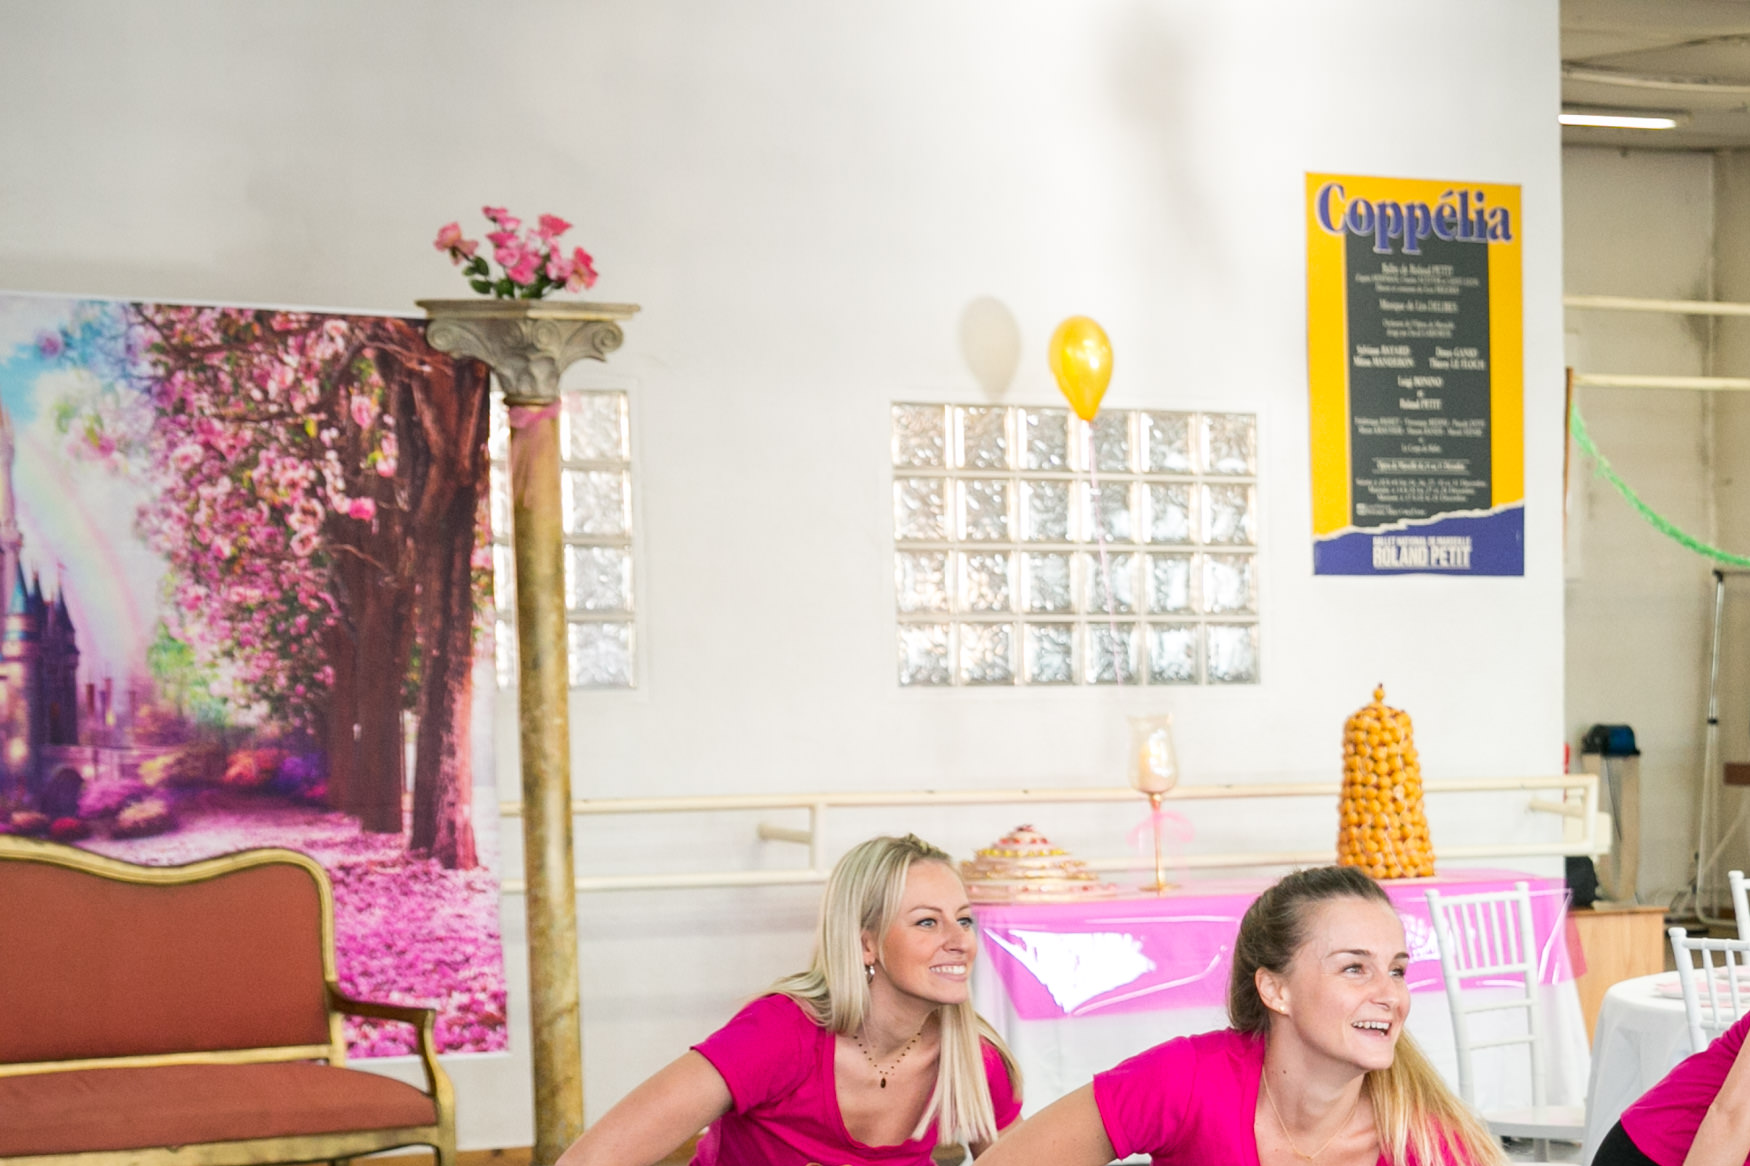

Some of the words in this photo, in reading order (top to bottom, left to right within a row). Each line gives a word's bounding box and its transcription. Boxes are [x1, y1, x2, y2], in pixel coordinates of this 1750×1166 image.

[1316, 181, 1513, 255] Coppélia
[1373, 546, 1429, 568] ROLAND
[1430, 546, 1472, 569] PETIT
